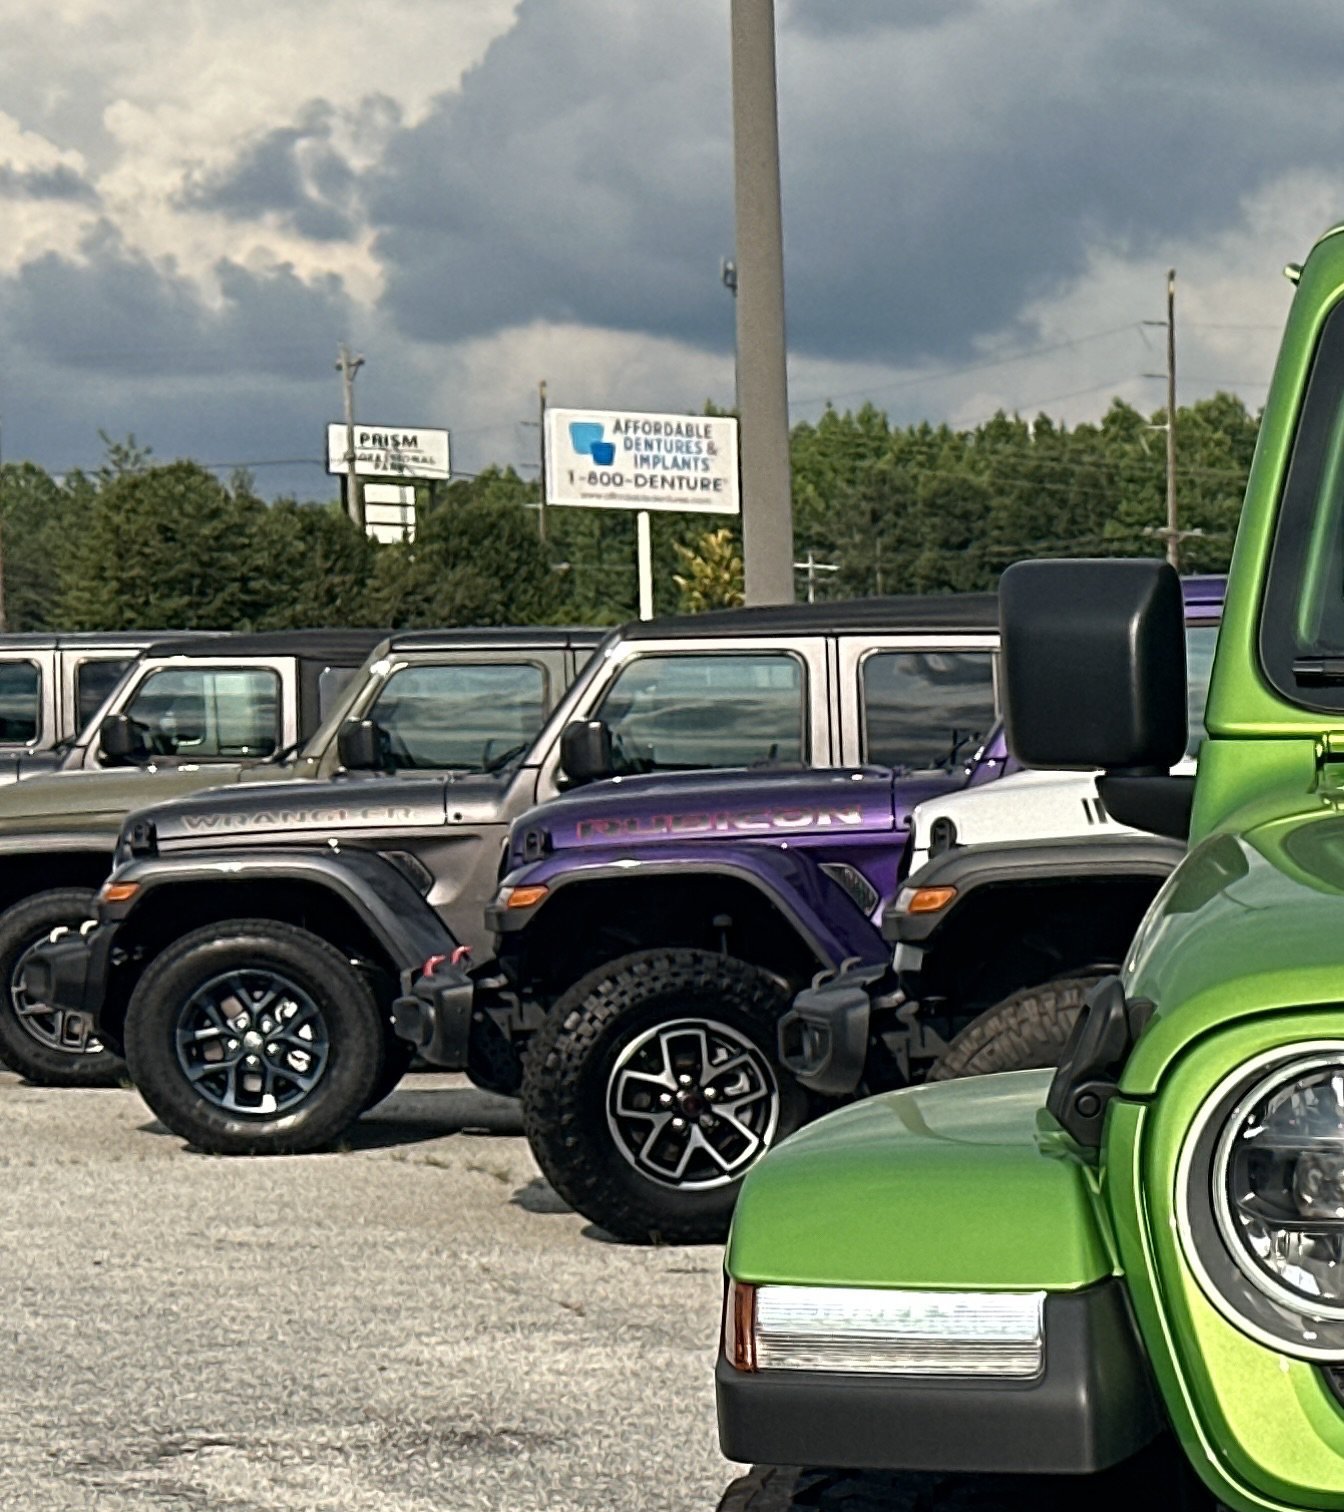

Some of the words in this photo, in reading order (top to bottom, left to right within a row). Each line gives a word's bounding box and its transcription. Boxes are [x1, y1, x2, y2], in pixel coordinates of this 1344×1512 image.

[359, 431, 419, 448] PRISM
[612, 418, 714, 440] AFFORDABLE
[623, 435, 703, 456] DENTURES
[706, 440, 719, 456] &
[634, 453, 711, 473] IMPLANTS
[567, 470, 724, 493] 1-800-DENTURE
[576, 804, 862, 840] RUBICON
